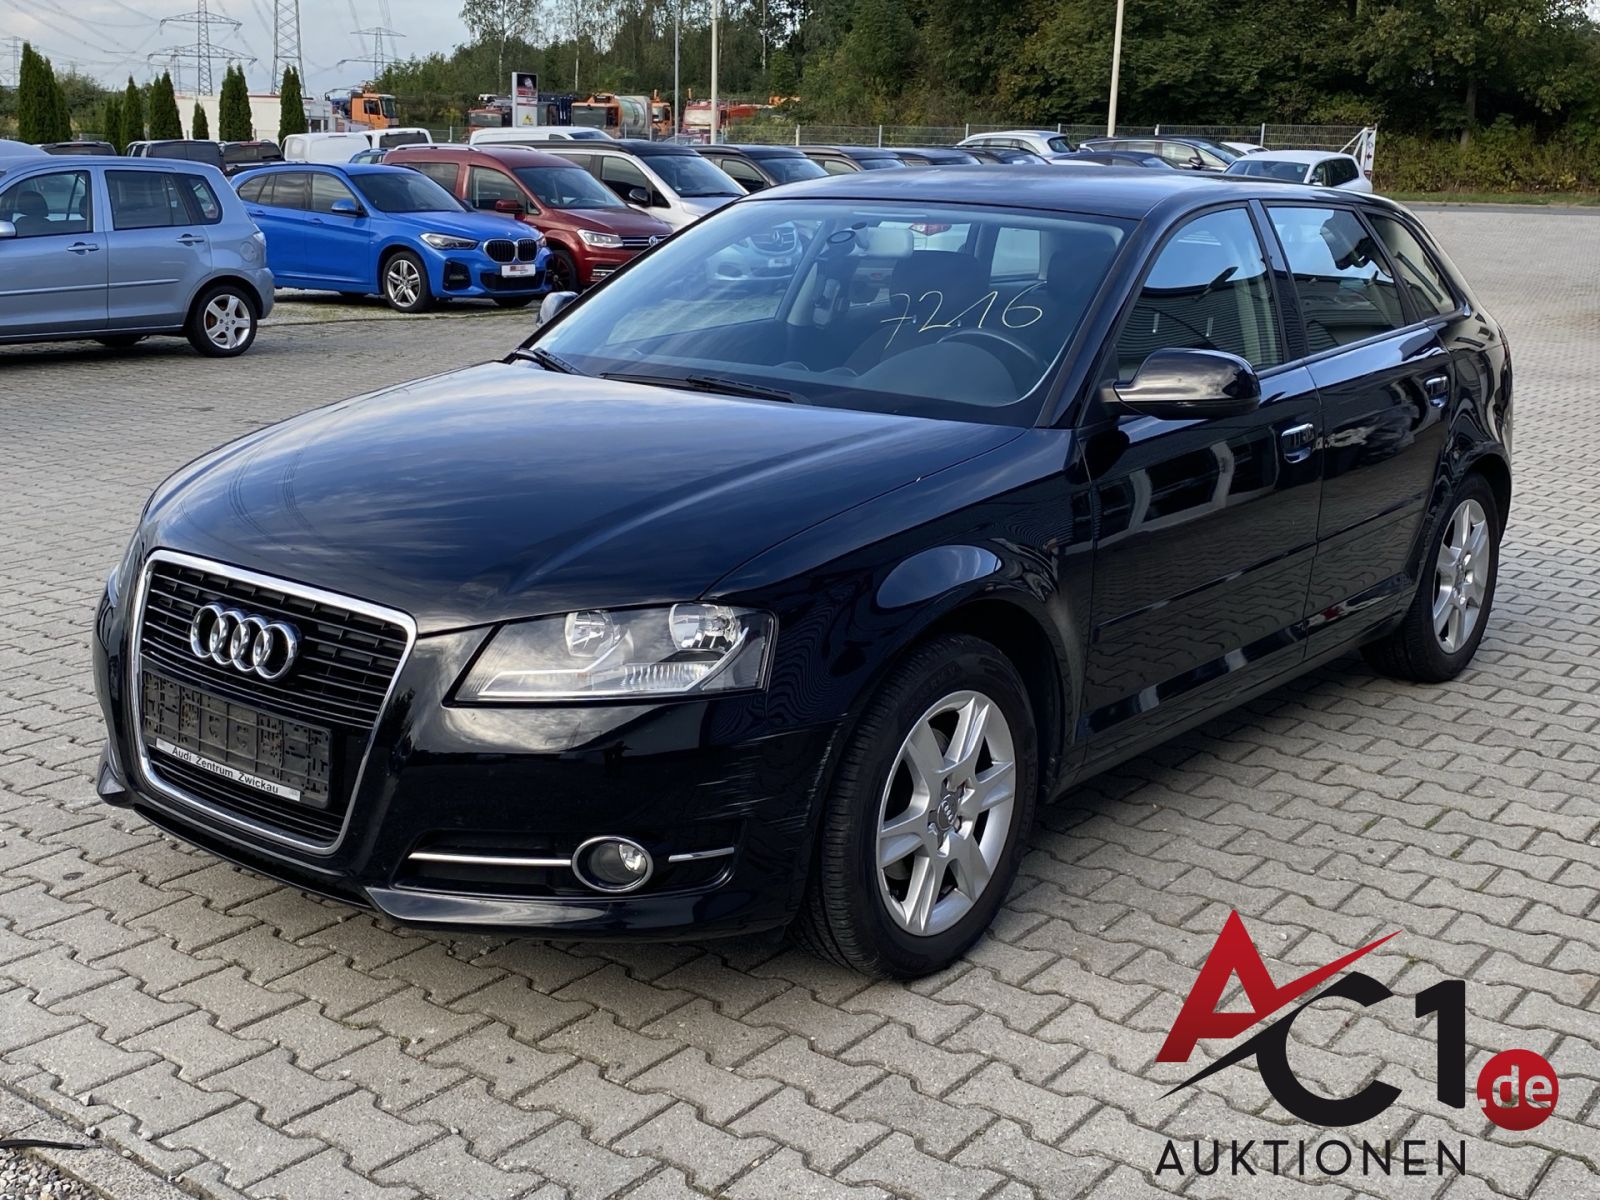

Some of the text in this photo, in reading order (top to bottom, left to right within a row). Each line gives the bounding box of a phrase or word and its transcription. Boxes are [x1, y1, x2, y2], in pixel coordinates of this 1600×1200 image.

[880, 281, 1048, 350] 7216
[172, 746, 279, 794] Audi Zentrum Zwickau
